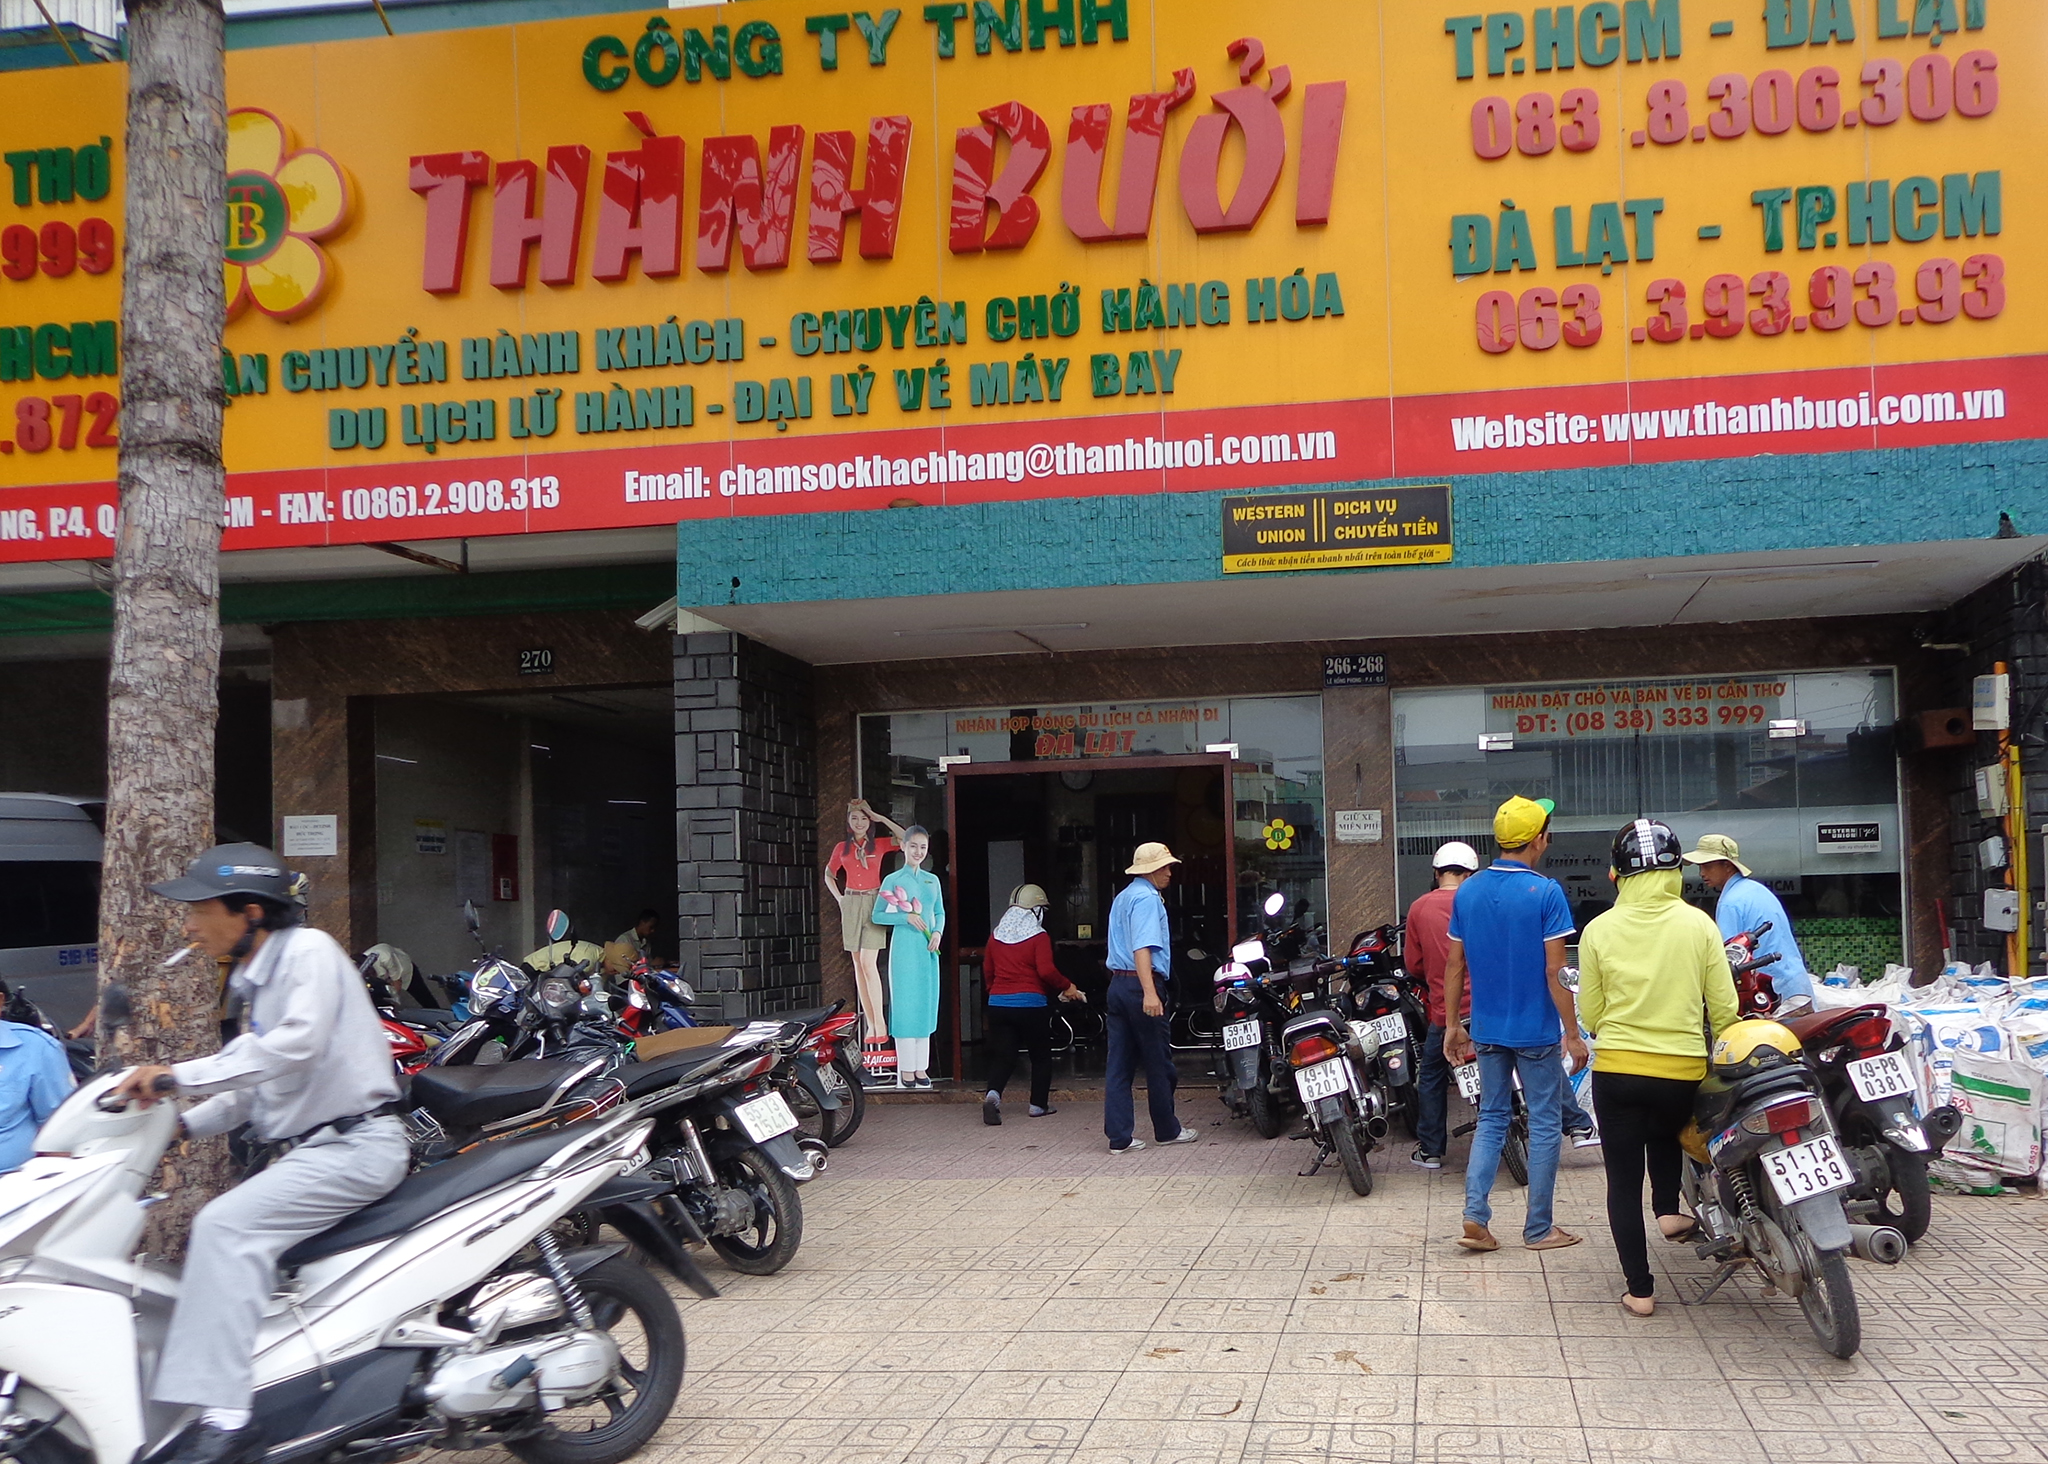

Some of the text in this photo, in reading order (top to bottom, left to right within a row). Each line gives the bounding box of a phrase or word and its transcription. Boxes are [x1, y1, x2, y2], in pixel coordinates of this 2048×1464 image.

[582, 0, 1129, 92] CÔNG TY TNHH
[1445, 0, 1682, 79] TP.HCM
[1470, 49, 2000, 159] 083 .8.306.306
[4, 135, 113, 206] THƠ
[409, 37, 1347, 294] THÀNH BƯỞI
[1448, 198, 1536, 276] ĐÀ
[1552, 198, 1665, 276] LẠT
[1751, 170, 2001, 252] TP.HCM
[0, 217, 115, 281] 999
[1475, 253, 2006, 354] 063 .3.93.93.93
[281, 327, 446, 393] CHUYỂN
[461, 329, 579, 381] HÀNH
[595, 315, 744, 371] KHÁCH
[790, 295, 967, 356] CHUYÊN
[985, 281, 1081, 342] CHỞ
[1101, 278, 1230, 333] HÀNG
[1246, 267, 1344, 323] HÓA
[329, 407, 386, 450] DU
[402, 399, 496, 453] LỊCH
[509, 388, 562, 438] LỮ
[575, 382, 693, 434] HÀNH
[733, 376, 812, 431] ĐẠI
[831, 363, 876, 416] LÝ
[893, 358, 952, 411] VÉ
[970, 352, 1070, 407] MÁY
[1090, 348, 1182, 398] BAY
[624, 427, 1337, 503] Email: chamsockhachhang@thanhbuoi.com.vn
[279, 491, 334, 525] FAX:
[342, 476, 560, 519] (086).2.908.313
[1334, 499, 1397, 520] DỊCH VỤ
[1233, 504, 1306, 544] WESTERN UNION
[1334, 515, 1438, 540] CHUYỂN TIỀN
[1236, 557, 1256, 568] Cách
[1299, 552, 1316, 565] tiền
[1317, 553, 1343, 564] nhanh
[1344, 551, 1364, 563] nhất
[1365, 551, 1382, 561] trên
[1384, 549, 1402, 560] toàn
[1403, 547, 1418, 559] thế
[520, 650, 552, 668] 270
[1492, 691, 1537, 710] NHẬN
[1636, 686, 1668, 703] BÁN
[1673, 684, 1692, 700] VÉ
[1695, 685, 1712, 699] ĐI
[1717, 680, 1748, 699] CẦN
[1753, 682, 1787, 698] THƠ
[956, 718, 996, 733] NHẬN
[1000, 715, 1030, 733] HỢP
[1033, 711, 1076, 730] ĐỒNG
[1079, 713, 1099, 727] DU
[1102, 711, 1132, 728] LỊCH
[1158, 706, 1199, 723] NHÂN
[1204, 707, 1219, 721] ĐI
[1516, 704, 1765, 736] ĐT: (08 38) 333 999
[1035, 727, 1137, 758] ĐÀ LẠT
[1343, 812, 1374, 821] GIỮ XE
[1364, 820, 1379, 830] PHÍ
[1684, 882, 1709, 896] P.4,
[1228, 1023, 1254, 1036] 59-M1
[1370, 1016, 1397, 1031] 59-U1
[1376, 1026, 1404, 1044] 10.29
[1226, 1033, 1258, 1048] 800.91
[1304, 1062, 1336, 1083] 49-V4
[1858, 1056, 1900, 1080] 49-P8
[1306, 1077, 1340, 1098] 8201
[1864, 1074, 1908, 1097] 0381
[1771, 1138, 1832, 1175] 51-T8
[1784, 1161, 1843, 1196] 1369
